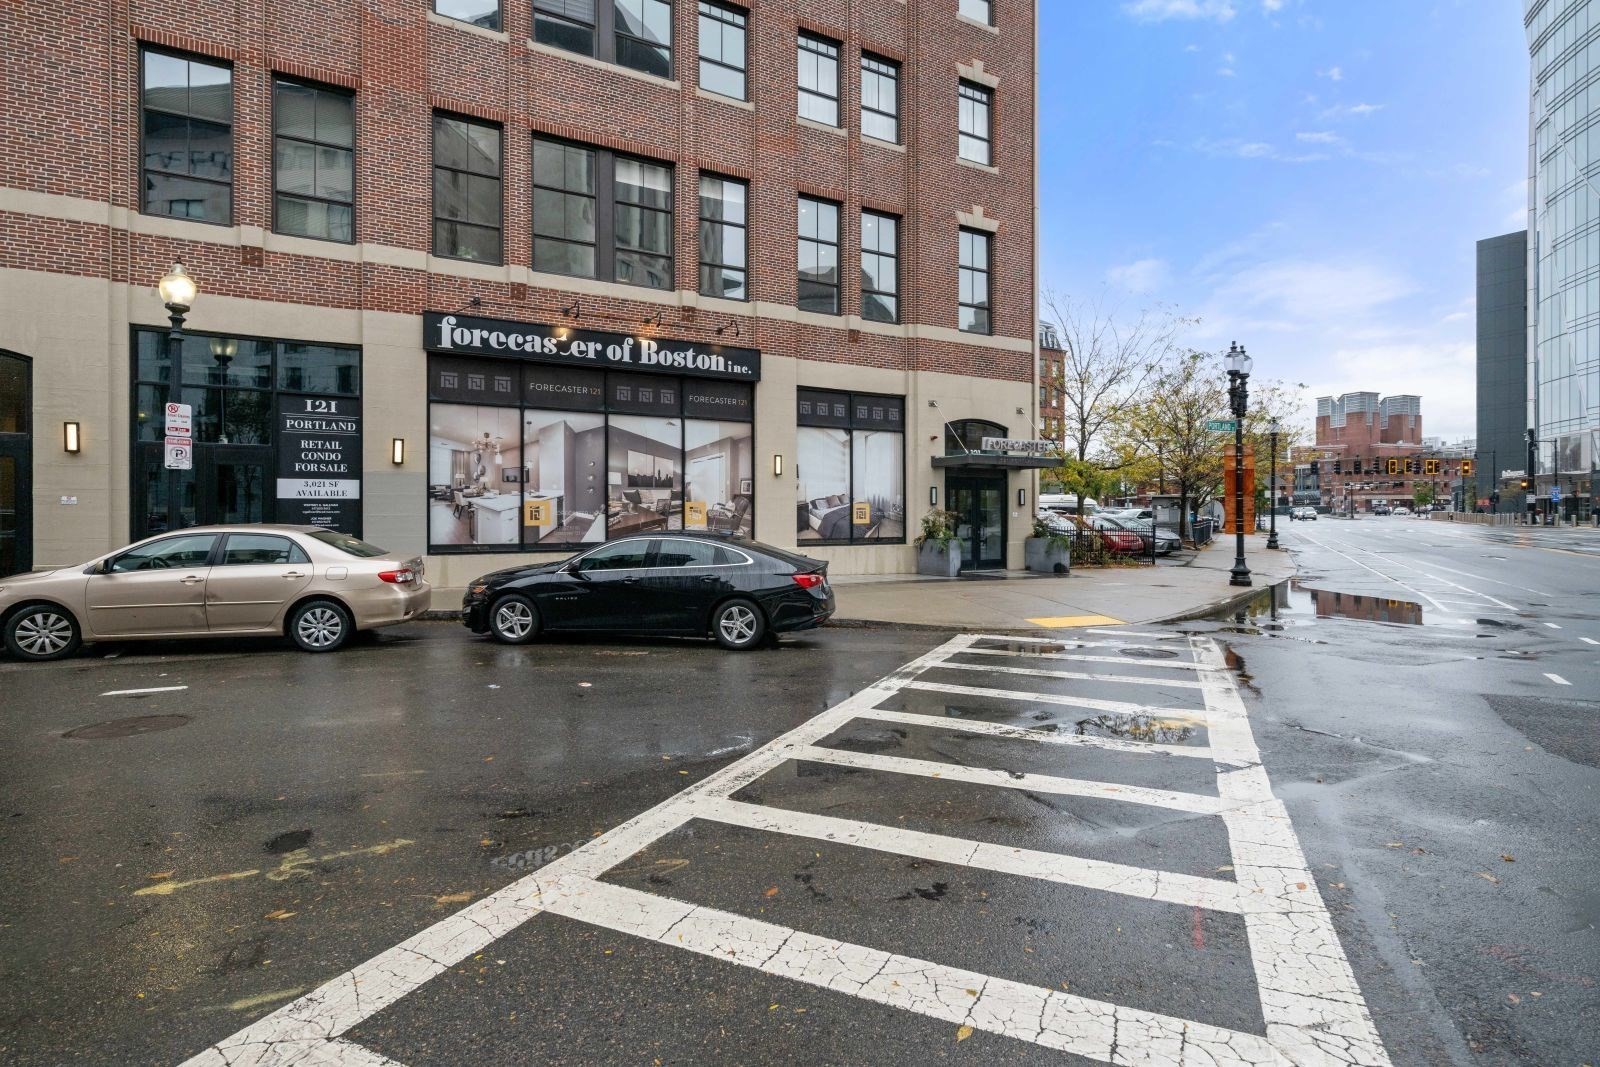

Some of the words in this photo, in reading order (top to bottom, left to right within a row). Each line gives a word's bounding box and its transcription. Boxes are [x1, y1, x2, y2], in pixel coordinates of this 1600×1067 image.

[606, 337, 634, 363] of
[638, 338, 726, 372] Boston
[727, 360, 752, 375] inc.
[529, 382, 588, 395] FORECASTER
[589, 387, 601, 396] 121
[688, 395, 737, 406] FORECASTER
[738, 398, 748, 407] 121
[286, 419, 356, 432] PORTLAND
[300, 440, 342, 450] RETAIL
[301, 451, 341, 461] CONDO
[294, 463, 318, 472] FOR
[320, 463, 348, 473] SALE
[303, 480, 326, 489] 3,021
[328, 480, 340, 488] SF
[296, 489, 348, 497] AVAILABLE
